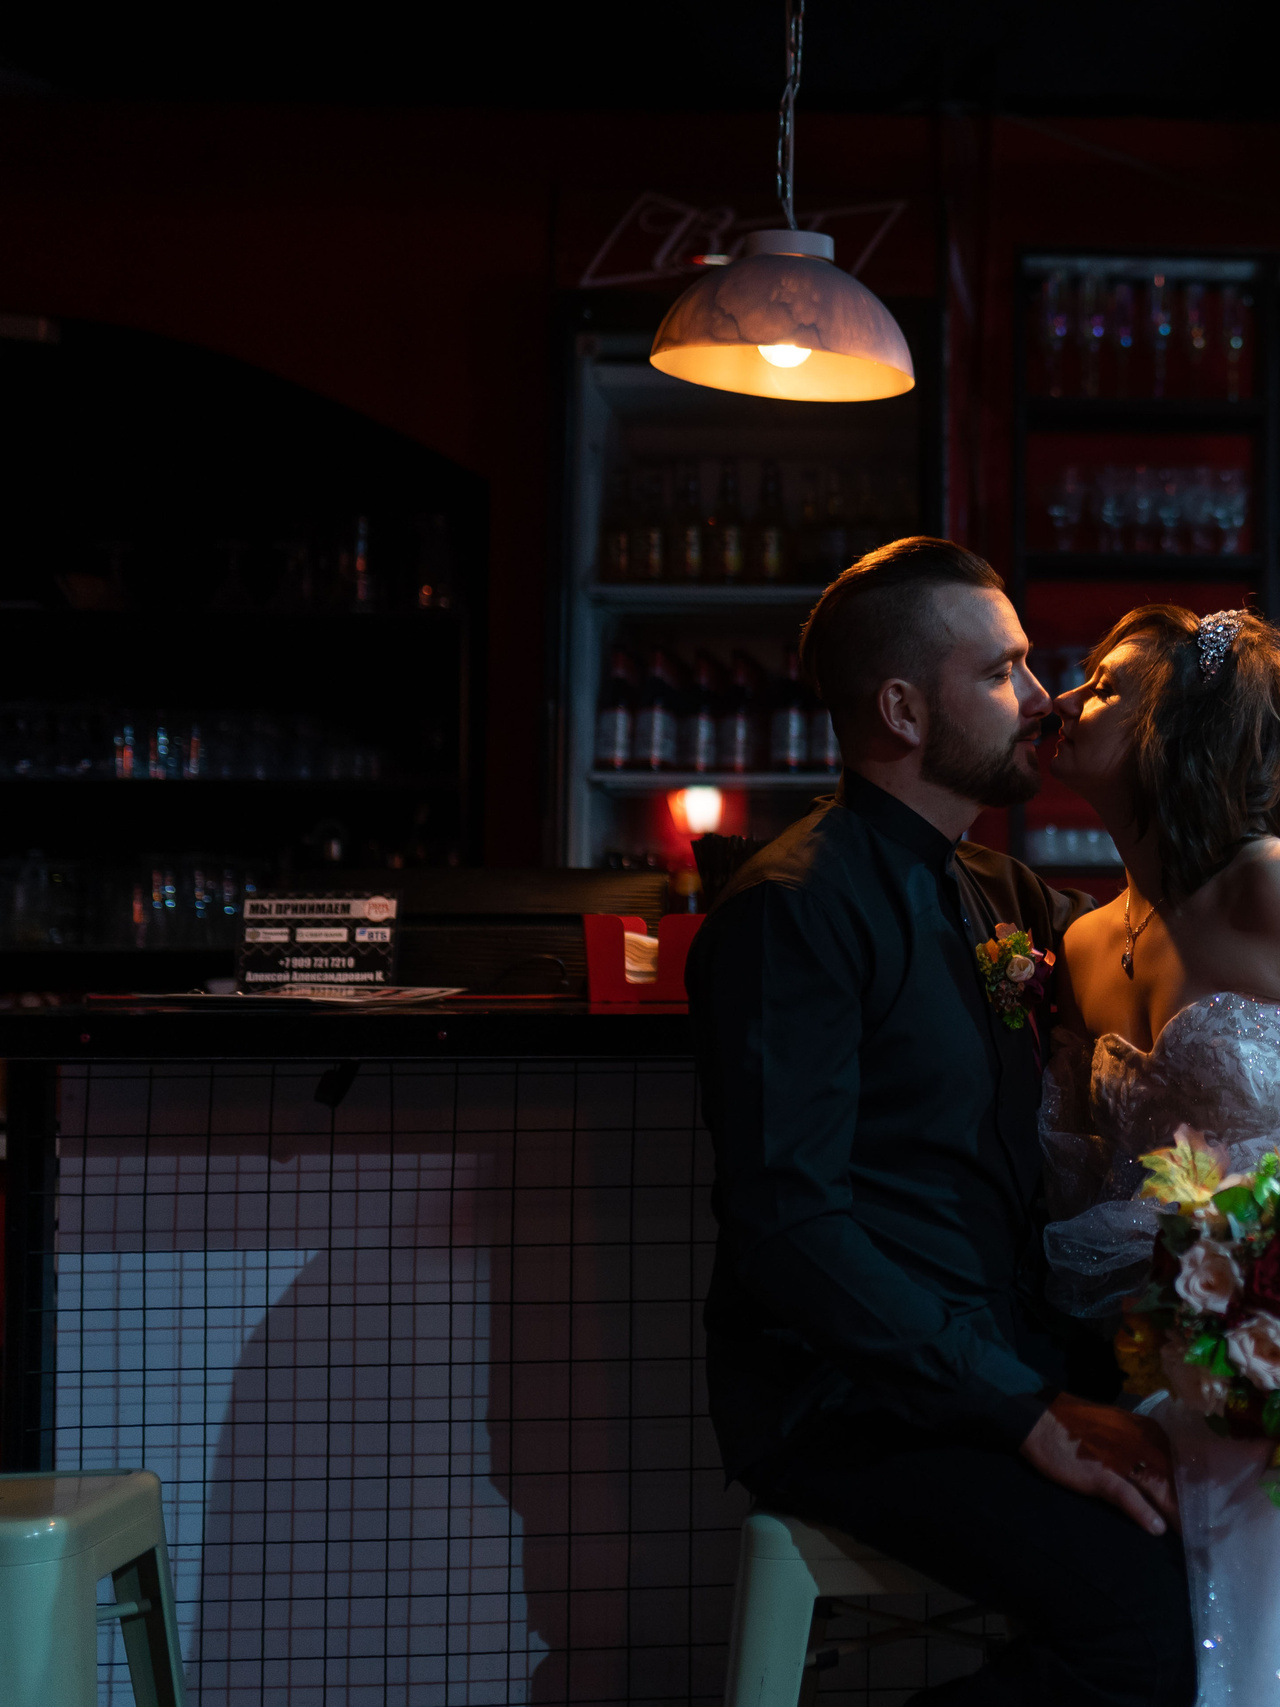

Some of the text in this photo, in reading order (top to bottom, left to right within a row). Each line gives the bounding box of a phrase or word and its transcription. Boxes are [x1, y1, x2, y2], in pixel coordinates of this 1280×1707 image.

[249, 903, 351, 915] МЫ ПРИНИМАЕМ
[367, 931, 388, 941] ВТБ
[278, 956, 290, 969] +7
[347, 956, 355, 969] 0
[245, 971, 290, 982] Алексей
[291, 971, 374, 983] Александрович
